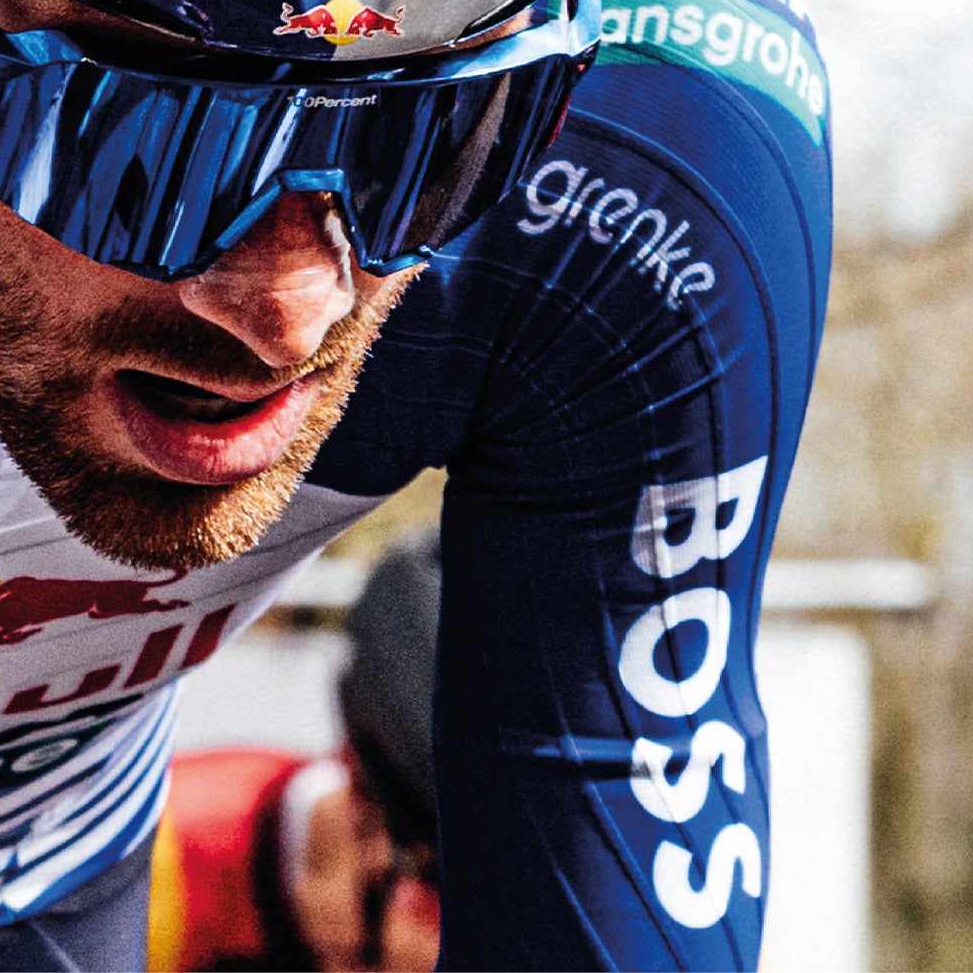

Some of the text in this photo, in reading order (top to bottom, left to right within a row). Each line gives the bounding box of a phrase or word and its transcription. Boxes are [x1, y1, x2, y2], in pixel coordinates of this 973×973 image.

[600, 4, 825, 115] ansgrohe
[517, 160, 716, 311] grenke
[618, 454, 769, 929] BOSS
